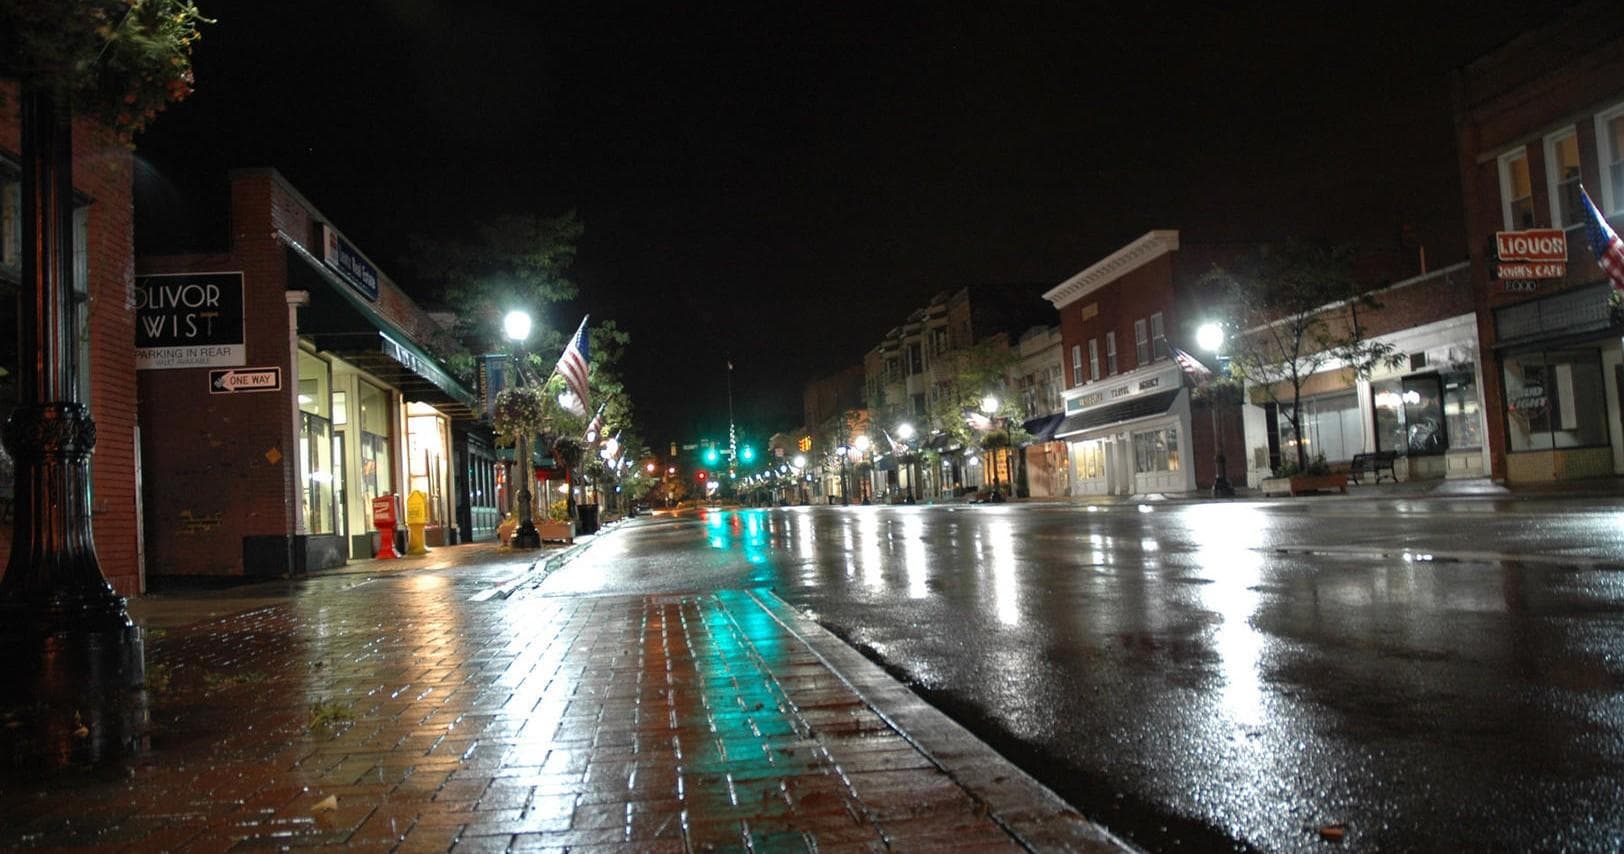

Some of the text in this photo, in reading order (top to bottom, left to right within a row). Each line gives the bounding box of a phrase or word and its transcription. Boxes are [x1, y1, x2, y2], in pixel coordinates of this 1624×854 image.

[1499, 237, 1563, 255] LIQUOR
[135, 347, 232, 359] PARKING IN REAR
[229, 374, 271, 385] ONE WAY
